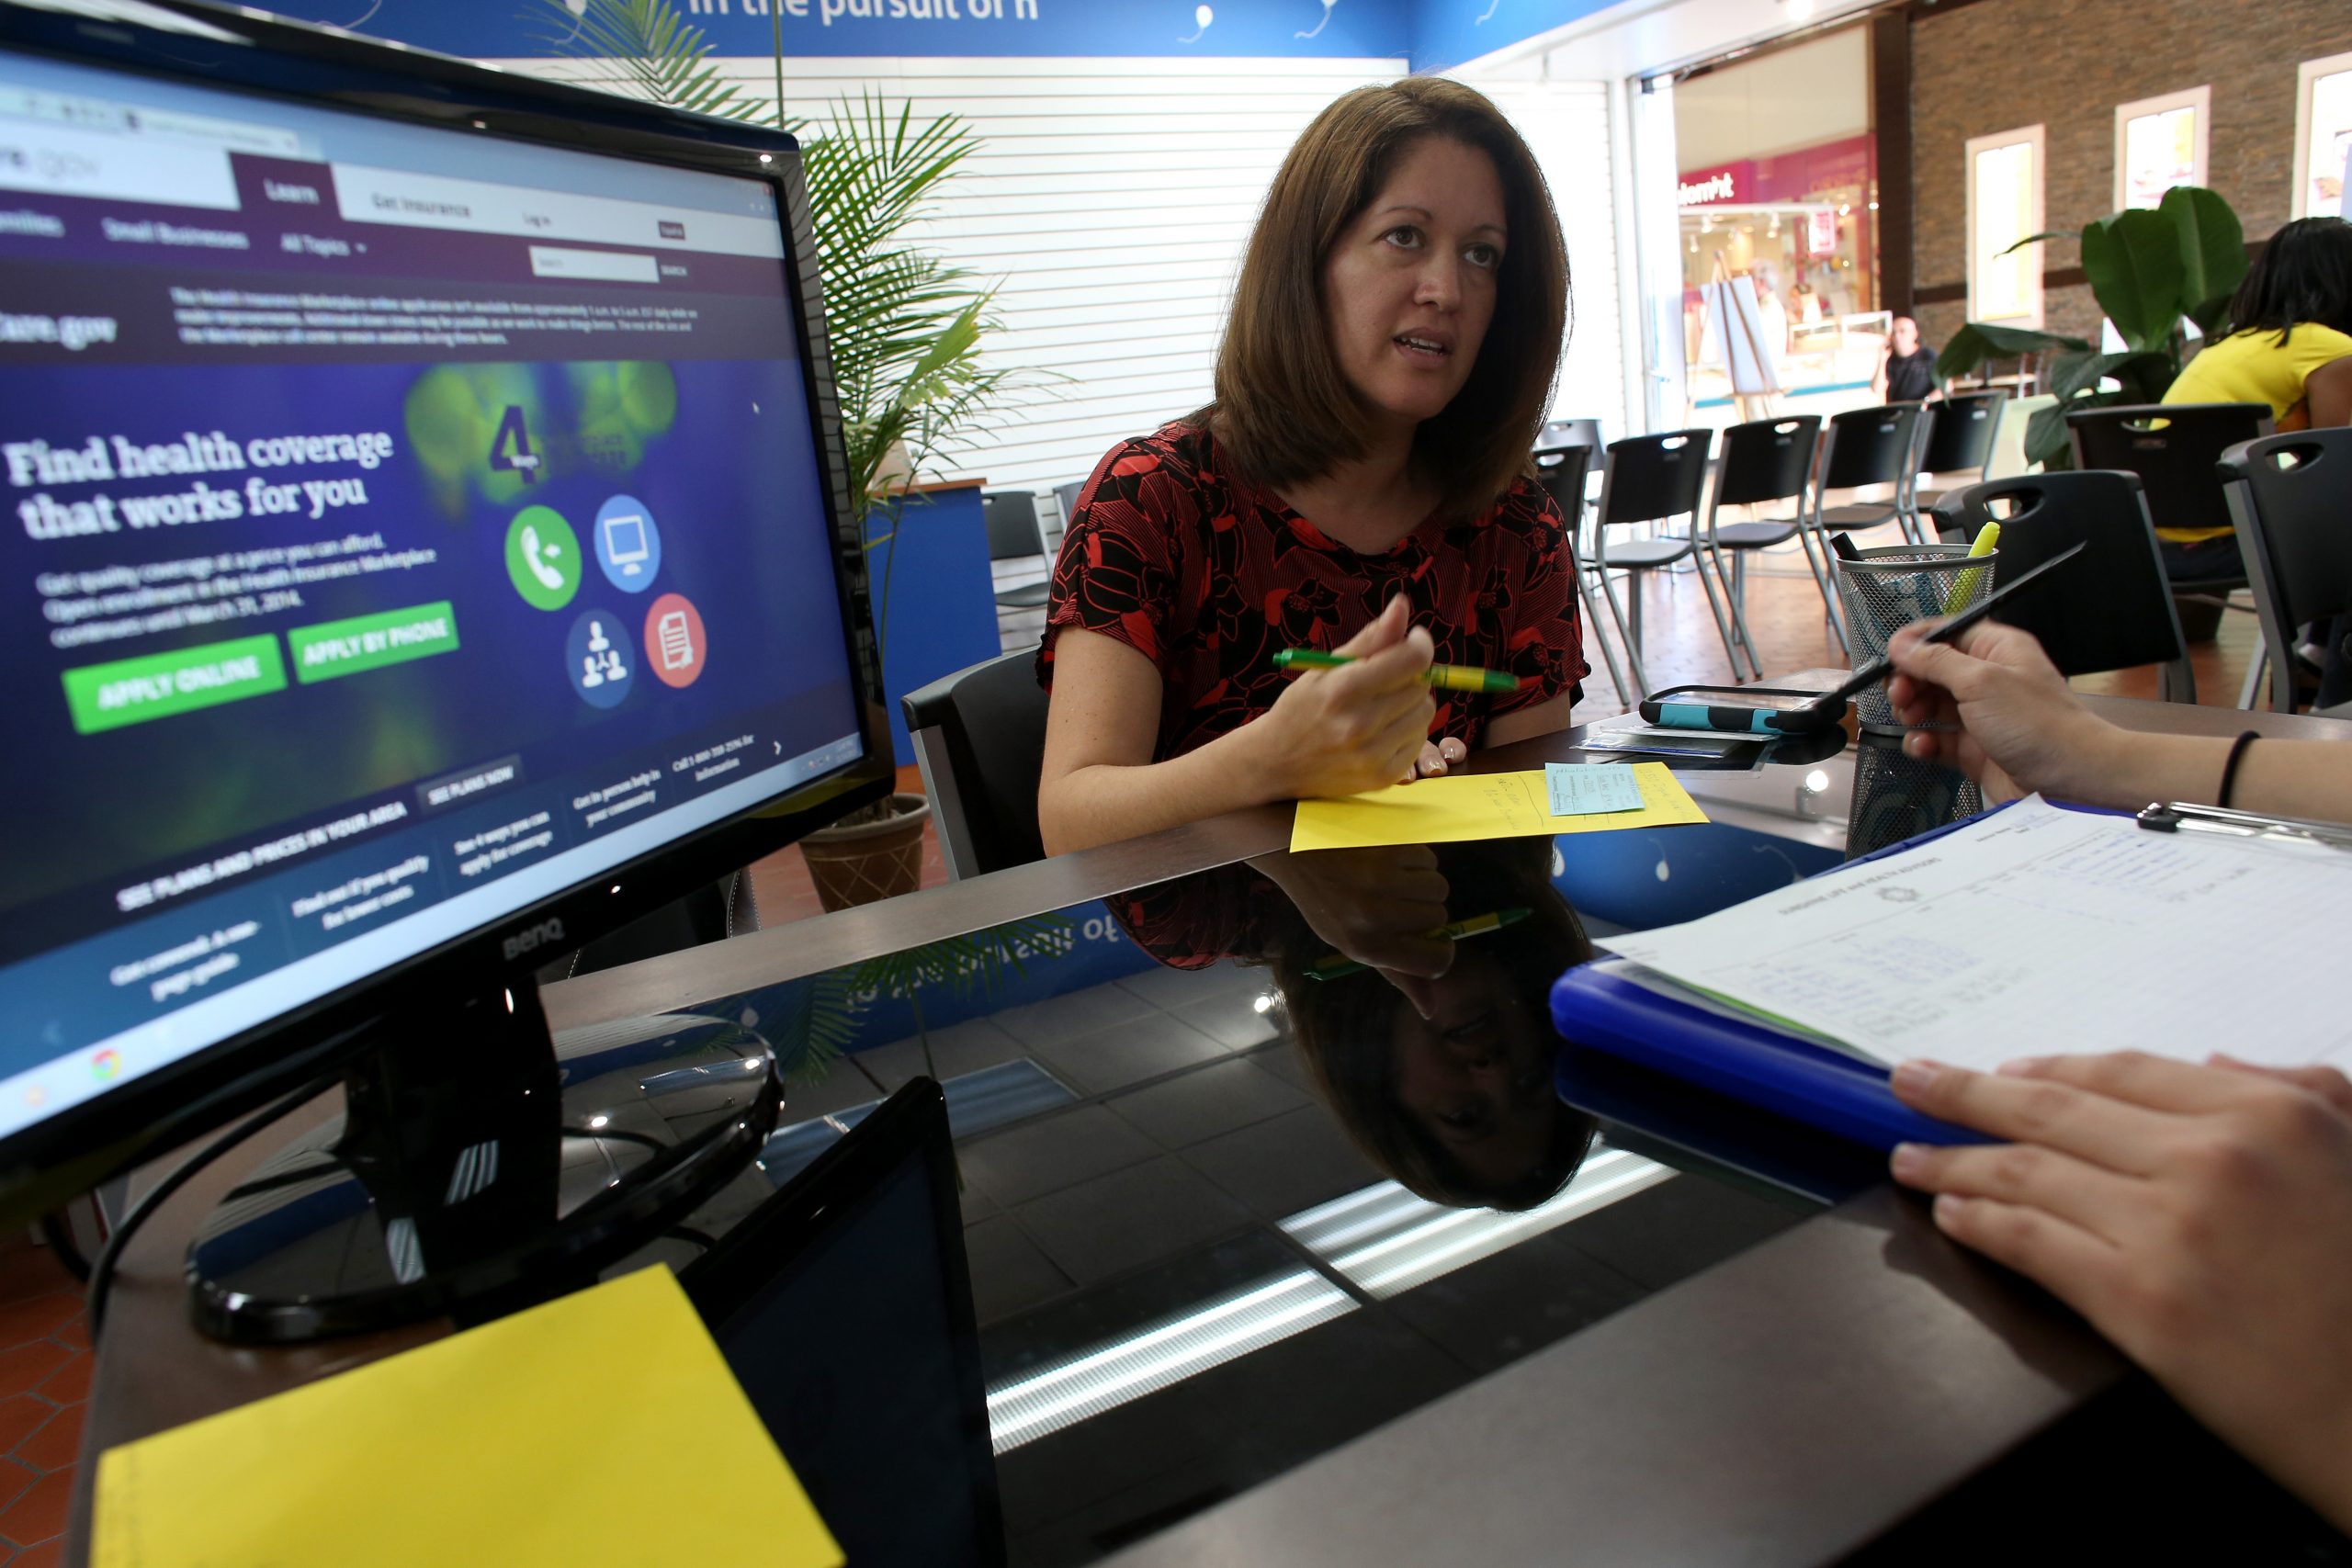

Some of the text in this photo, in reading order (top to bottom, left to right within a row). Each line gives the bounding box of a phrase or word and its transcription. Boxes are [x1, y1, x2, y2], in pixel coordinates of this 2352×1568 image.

[821, 0, 961, 26] pursuit
[263, 177, 321, 205] Learn
[371, 191, 471, 219] Get Insurance
[101, 216, 251, 250] Small Businesses
[302, 233, 351, 258] Topics
[2, 430, 395, 488] Find health coverage
[489, 405, 537, 485] 4
[17, 476, 369, 540] that works for you
[36, 571, 76, 597] Get
[77, 563, 141, 595] quality
[141, 556, 215, 583] coverage
[240, 566, 291, 592] Health
[290, 559, 360, 583] Insurance
[359, 547, 437, 573] Marketplace
[186, 599, 238, 626] March
[303, 617, 449, 666] APPLY BY PHONE
[96, 655, 262, 711] APPLY ONLINE
[426, 764, 514, 807] SEE PLANS NOW
[116, 800, 408, 912] SEE PLANS AND PRICES IN YOUR AREA
[503, 916, 565, 961] BenQ
